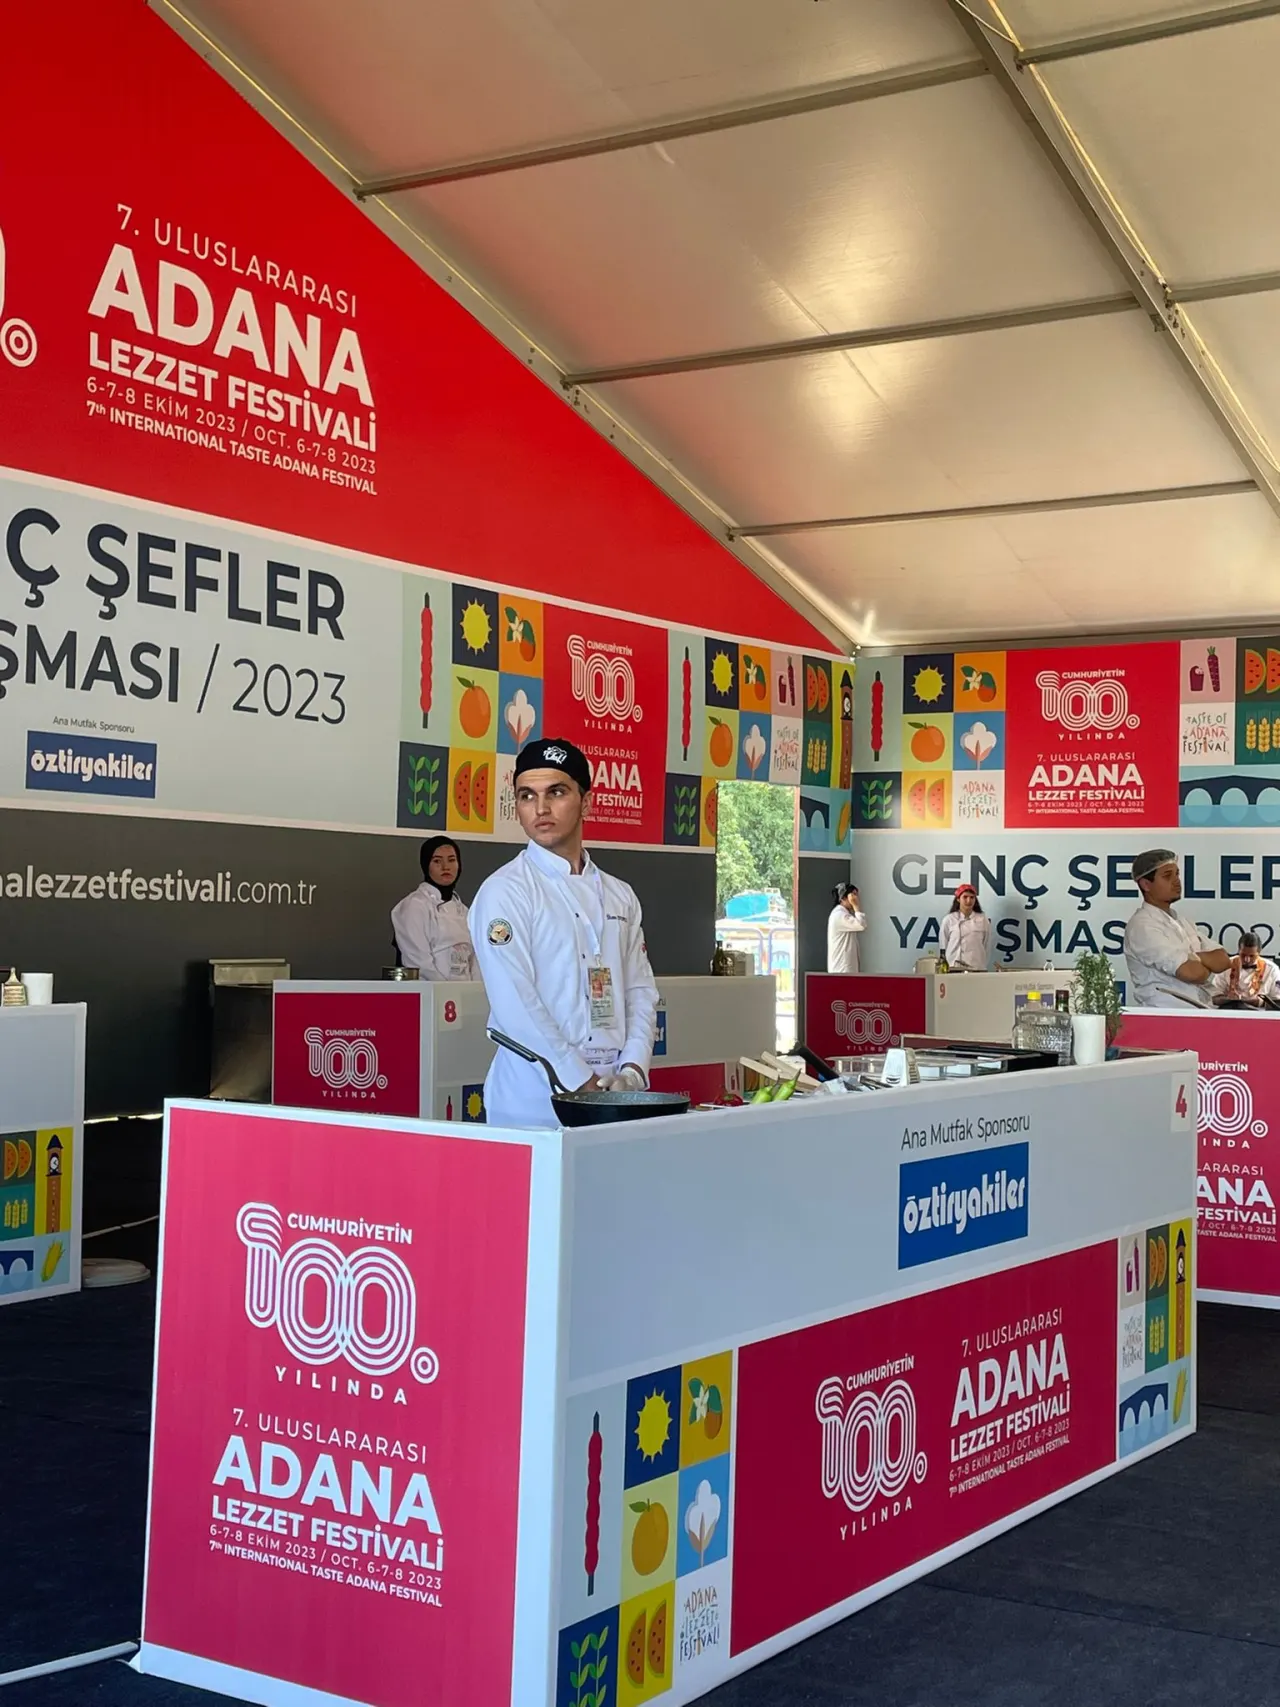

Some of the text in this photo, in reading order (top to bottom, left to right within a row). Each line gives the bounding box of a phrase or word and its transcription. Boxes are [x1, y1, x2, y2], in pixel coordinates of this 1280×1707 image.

[117, 203, 356, 318] 7. ULUSLARARASI
[88, 243, 374, 407] ADANA
[89, 332, 376, 452] LEZZET FESTİVALİ
[86, 376, 136, 405] 6-7-8
[144, 395, 189, 420] EKİM
[196, 408, 236, 433] 2023
[254, 425, 290, 450] OCT.
[296, 438, 336, 462] 6-7-8
[342, 452, 376, 474] 2023
[86, 400, 378, 496] 7th INTERNATIONAL TASTE ADANA FESTIVAL
[85, 523, 345, 641] ŞEFLER
[232, 658, 346, 725] 2023
[1062, 668, 1125, 679] CUMHURİYETİN
[52, 716, 135, 736] Ana Mutfak Sponsoru
[584, 720, 632, 734] YILINDA
[1058, 733, 1125, 741] YILINDA
[588, 759, 642, 792] ANA
[1028, 763, 1144, 788] ADANA
[1037, 752, 1135, 762] 7. ULUSLARARASI
[1029, 786, 1145, 801] LEZZET FESTİVALİ
[892, 853, 1280, 910] GENÇ ŞELE
[890, 914, 1126, 962] YAŞMAS
[939, 983, 946, 999] 9
[444, 1000, 457, 1023] 8
[1197, 1061, 1248, 1072] URİYETİN
[322, 1090, 376, 1098] YILINDA
[1175, 1084, 1187, 1118] 4
[901, 1114, 1030, 1150] Ana Mutfak Sponsoru
[1203, 1138, 1250, 1149] INDA
[1197, 1163, 1263, 1176] ARARASI
[1197, 1176, 1275, 1208] ANA
[287, 1212, 412, 1245] CUMHURİYETİN
[1218, 1230, 1243, 1239] ADANA
[1245, 1233, 1277, 1242] FESTIVAL
[1256, 1225, 1276, 1234] 2023
[961, 1307, 1062, 1357] 7. ULUSLARARASI
[275, 1365, 407, 1406] YILINDA
[846, 1353, 914, 1391] CUMHURİYETİN
[950, 1332, 1069, 1428] ADANA
[232, 1408, 427, 1464] 7. ULUSLARARASI
[950, 1383, 1070, 1463] LEZZET FESTİVALİ
[949, 1464, 969, 1481] 6-7-8
[972, 1453, 991, 1472] EKİM
[993, 1445, 1010, 1462] 2023
[1034, 1426, 1052, 1443] 6-7-8
[1054, 1418, 1070, 1434] 2023
[958, 1466, 1006, 1494] INTERNATIONAL
[1006, 1454, 1024, 1471] TASTE
[1024, 1446, 1044, 1462] ADANA
[1045, 1434, 1070, 1453] FESTIVAL
[212, 1435, 442, 1535] ADANA
[212, 1496, 443, 1572] LEZZET FESTİVALİ
[840, 1495, 912, 1541] YILINDA
[209, 1524, 243, 1542] 6-7-8
[248, 1532, 280, 1551] EKİM
[285, 1542, 316, 1560] 2023
[331, 1552, 362, 1571] OCT.
[368, 1560, 403, 1579] 6-7-8
[408, 1569, 442, 1590] 2023
[209, 1540, 442, 1607] 7th INTERNATIONAL TASTE ADANA FESTIVAL
